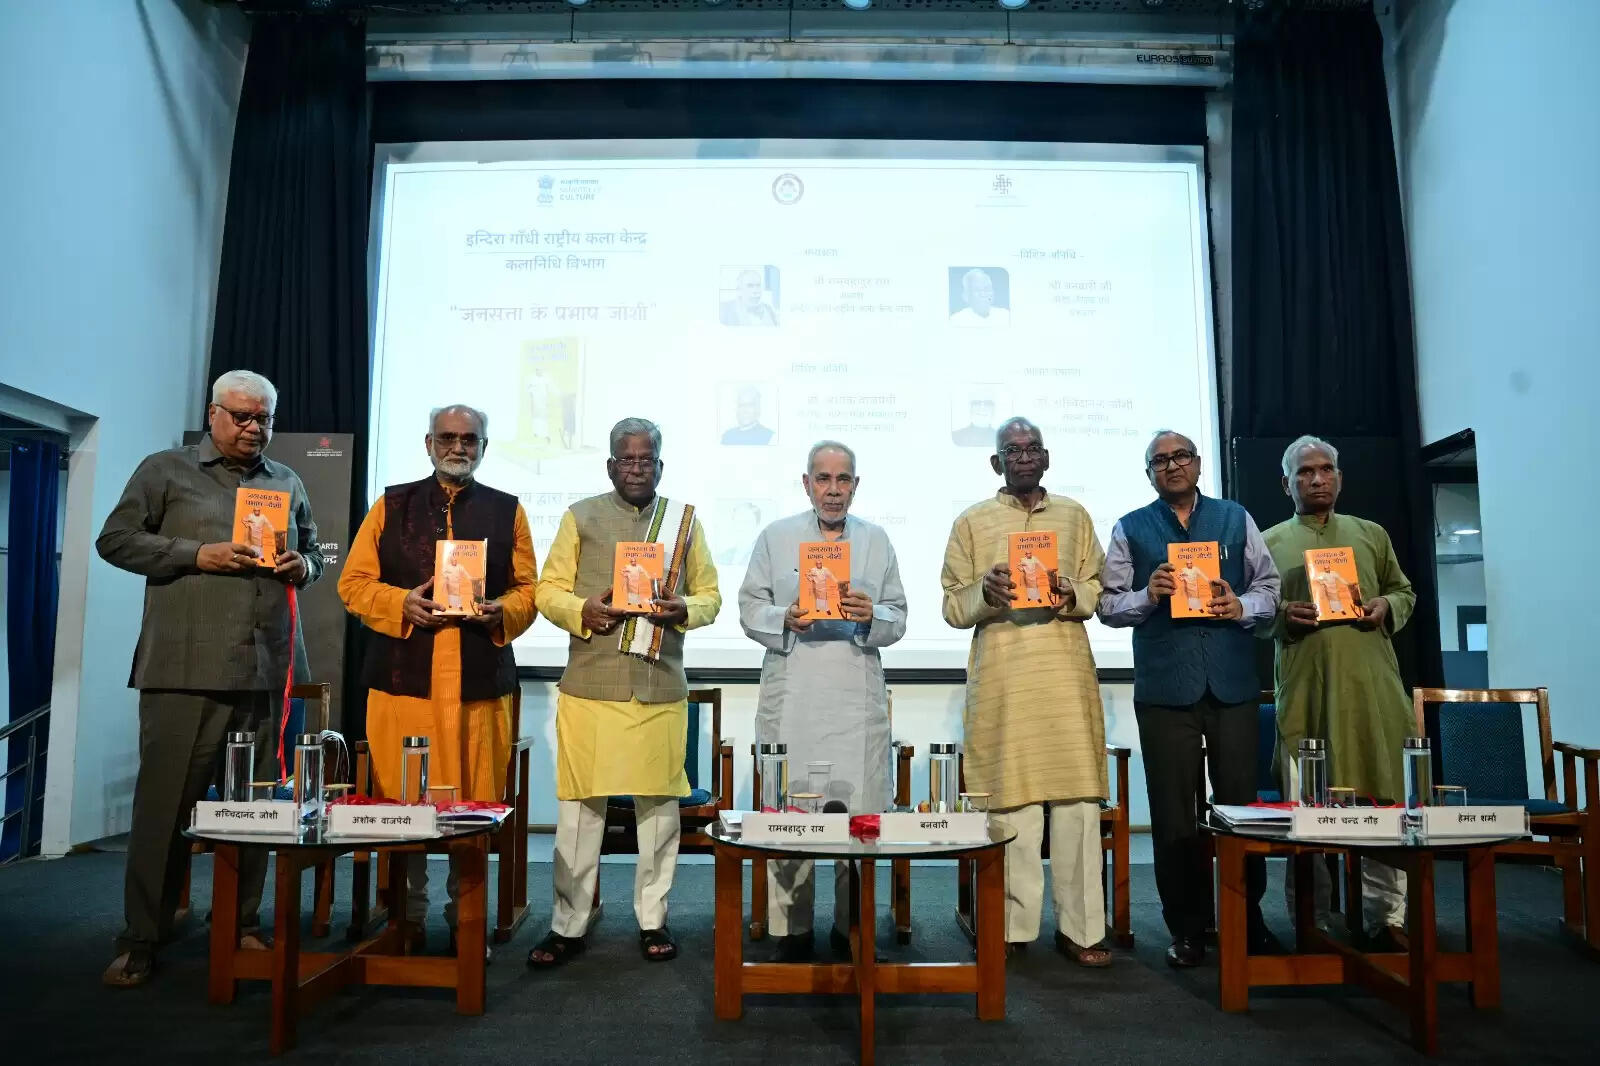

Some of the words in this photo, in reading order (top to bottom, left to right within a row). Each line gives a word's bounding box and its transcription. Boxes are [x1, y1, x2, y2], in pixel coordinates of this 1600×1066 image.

[466, 230, 505, 246] इन्दिरा
[509, 229, 539, 245] गाँधी
[543, 228, 580, 248] राष्ट्रीय
[585, 231, 615, 245] कला
[619, 228, 648, 245] केन्द्र
[505, 255, 561, 271] कलानिधि
[566, 254, 605, 270] विभाग
[214, 808, 256, 820] सच्चिदानंद
[259, 809, 278, 820] जोशी
[1458, 812, 1477, 823] हेमंत
[1480, 812, 1497, 823] शर्मा
[352, 815, 377, 825] अशोक
[380, 816, 411, 825] वाजपेयी
[920, 819, 949, 829] बनवारी
[1317, 815, 1337, 825] रमेश
[1341, 817, 1360, 825] चन्द्र
[768, 824, 806, 837] रामबहादुर
[810, 825, 825, 833] राय
